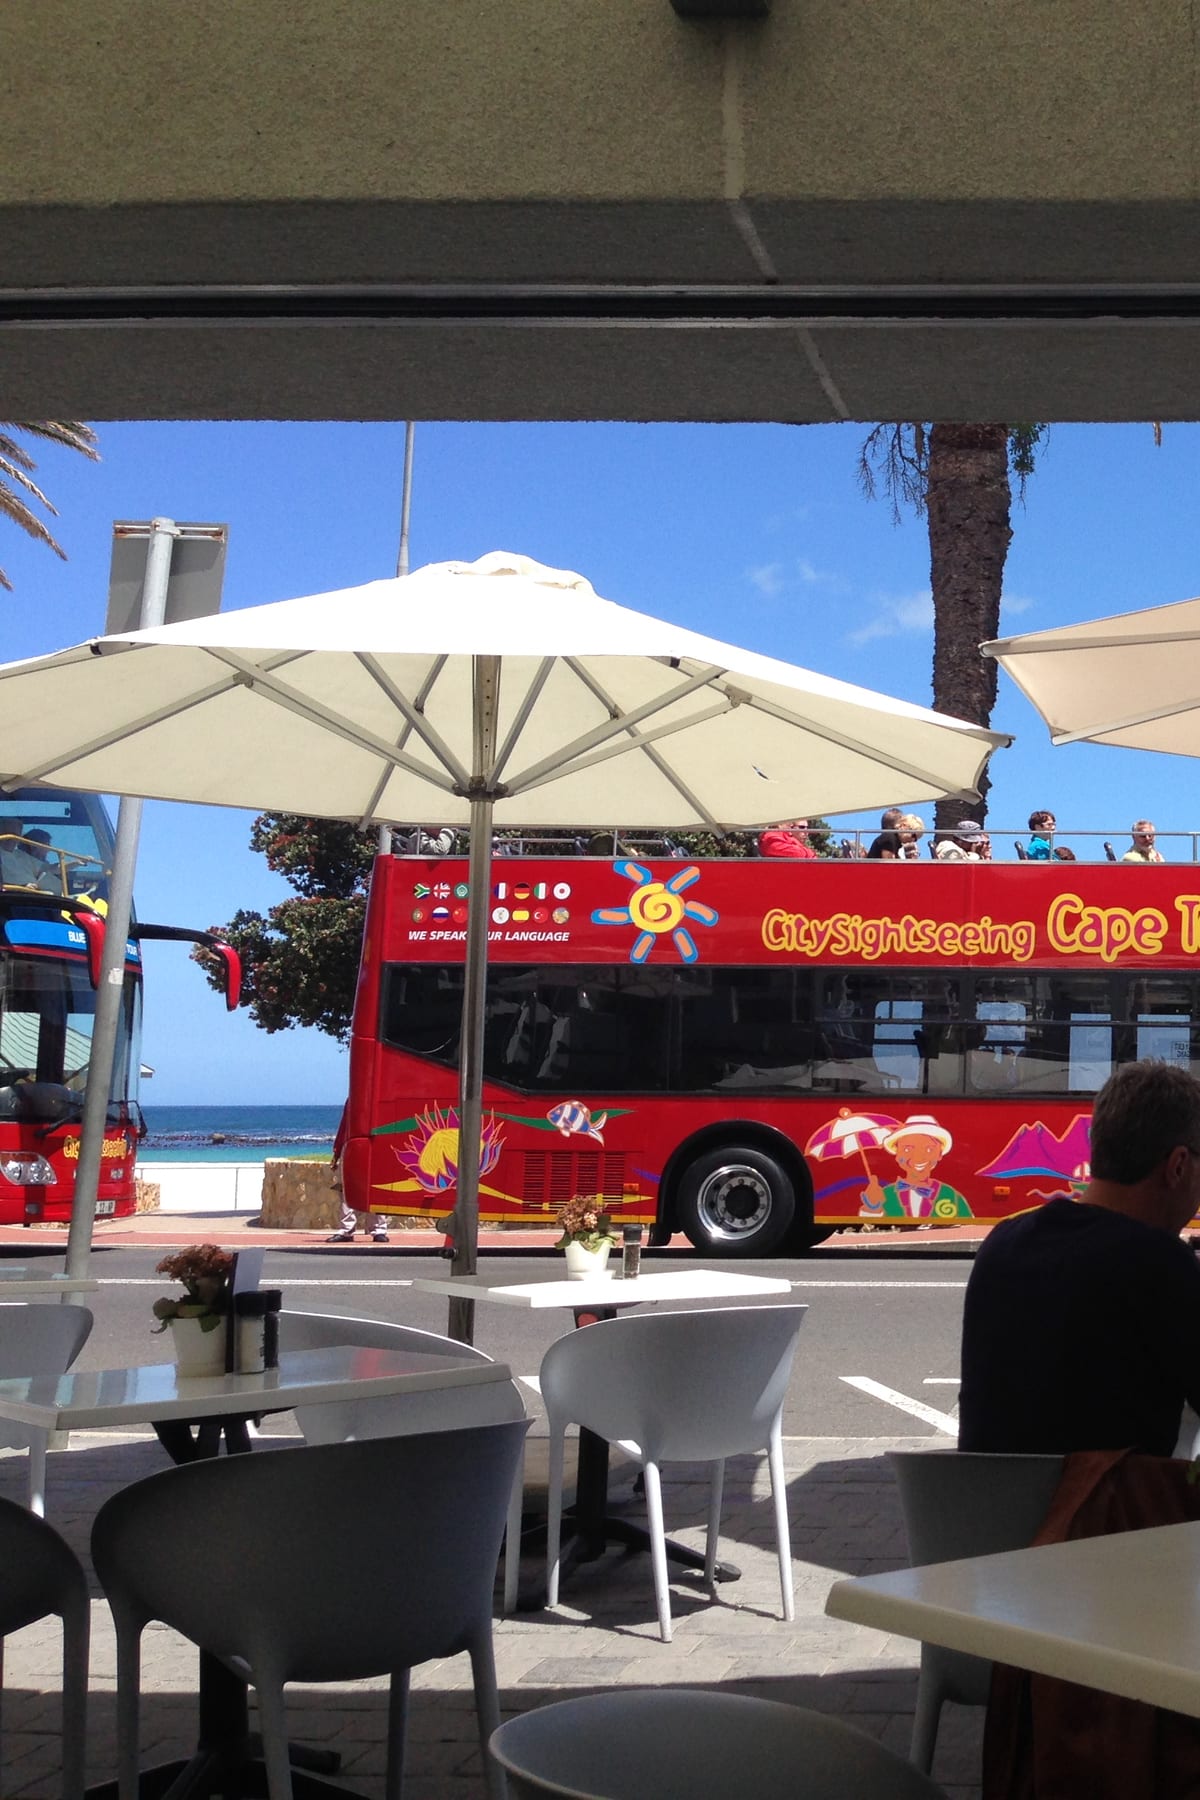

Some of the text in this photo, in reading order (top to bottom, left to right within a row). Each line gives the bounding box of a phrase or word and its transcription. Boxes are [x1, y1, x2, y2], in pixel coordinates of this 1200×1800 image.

[1047, 893, 1168, 963] Cape
[67, 930, 86, 944] BLUE
[408, 931, 570, 942] WE SPEAK UR LANGUAGE
